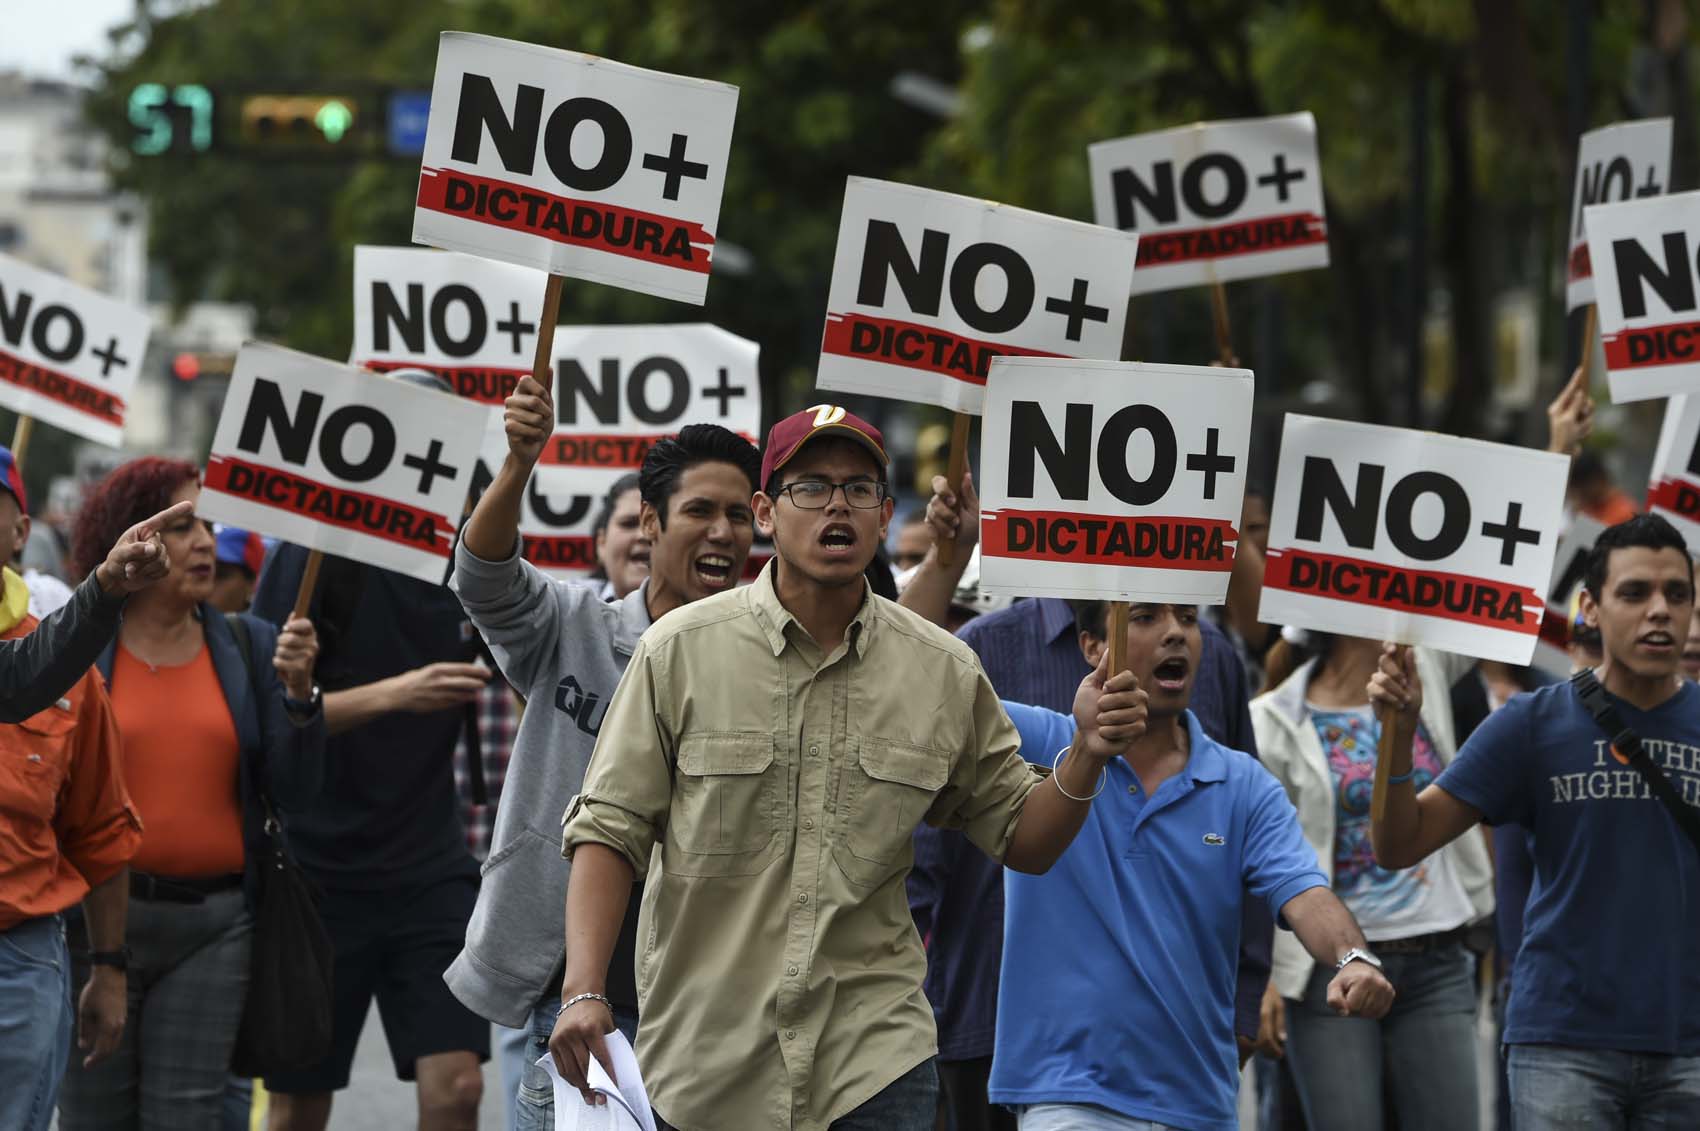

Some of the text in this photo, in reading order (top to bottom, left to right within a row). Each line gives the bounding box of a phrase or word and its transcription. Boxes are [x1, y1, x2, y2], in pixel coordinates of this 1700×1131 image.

[128, 83, 213, 156] 57
[444, 178, 693, 261] DICTADURA
[1612, 231, 1700, 319] N
[226, 465, 437, 545] DICTADURA
[1007, 517, 1224, 561] DICTADURA
[1289, 557, 1524, 624] DICTADURA
[1593, 740, 1607, 766] I
